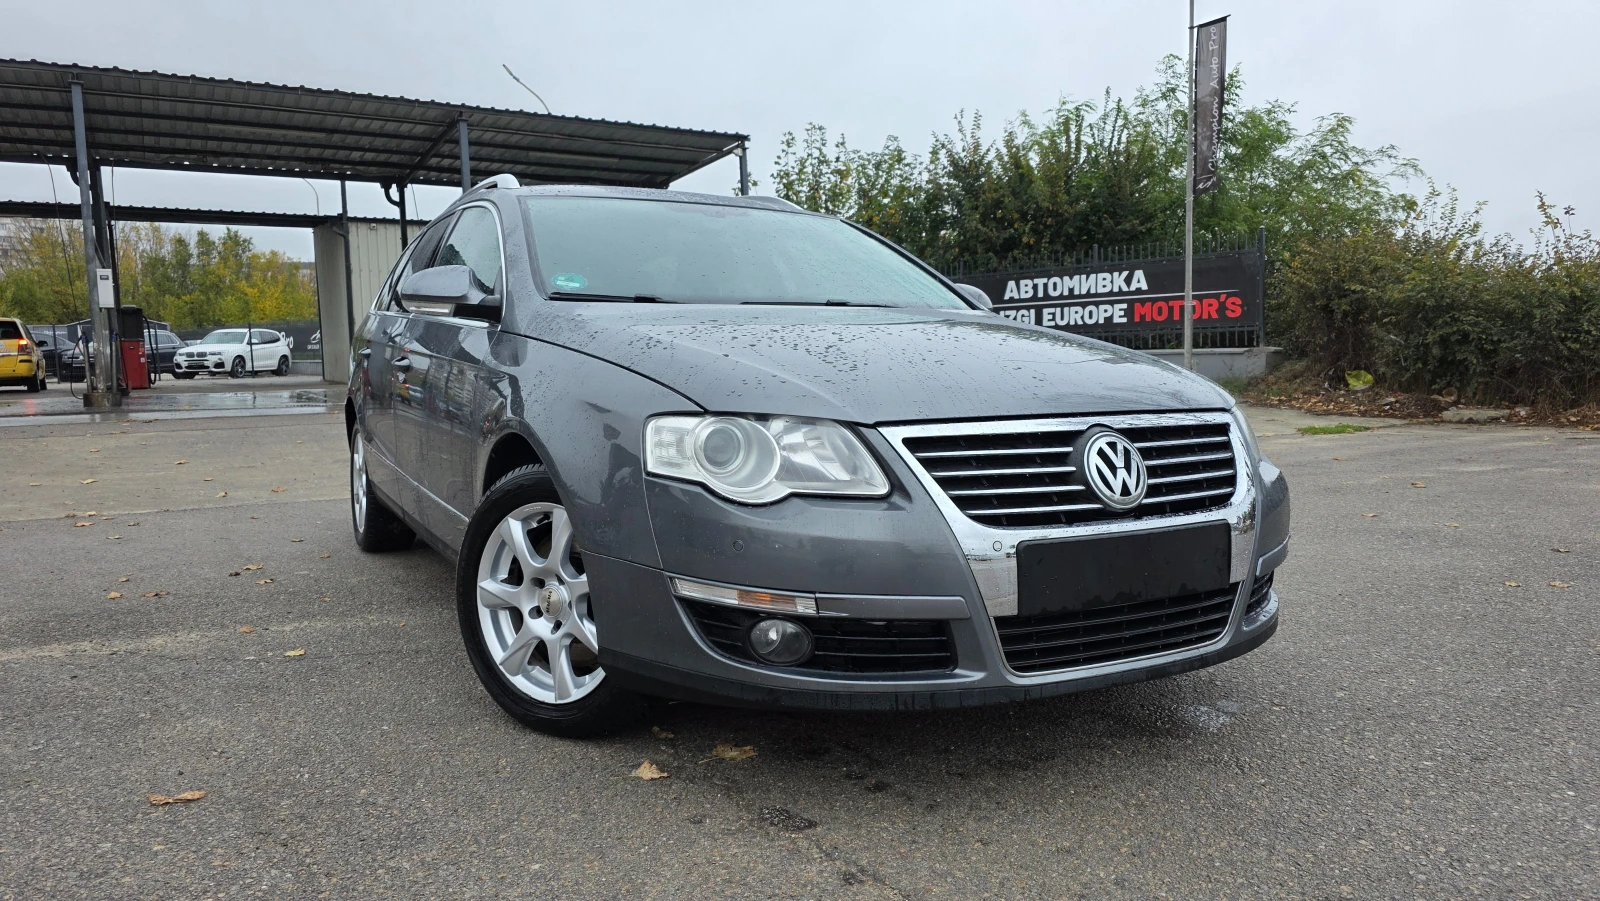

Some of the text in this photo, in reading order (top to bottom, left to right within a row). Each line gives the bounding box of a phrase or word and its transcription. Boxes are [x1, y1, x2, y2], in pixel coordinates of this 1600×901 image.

[1208, 26, 1221, 171] Champion Auto Pro
[1004, 269, 1148, 300] АВТОМИВКА
[1042, 303, 1128, 327] EUROPE
[1090, 437, 1143, 502] VW
